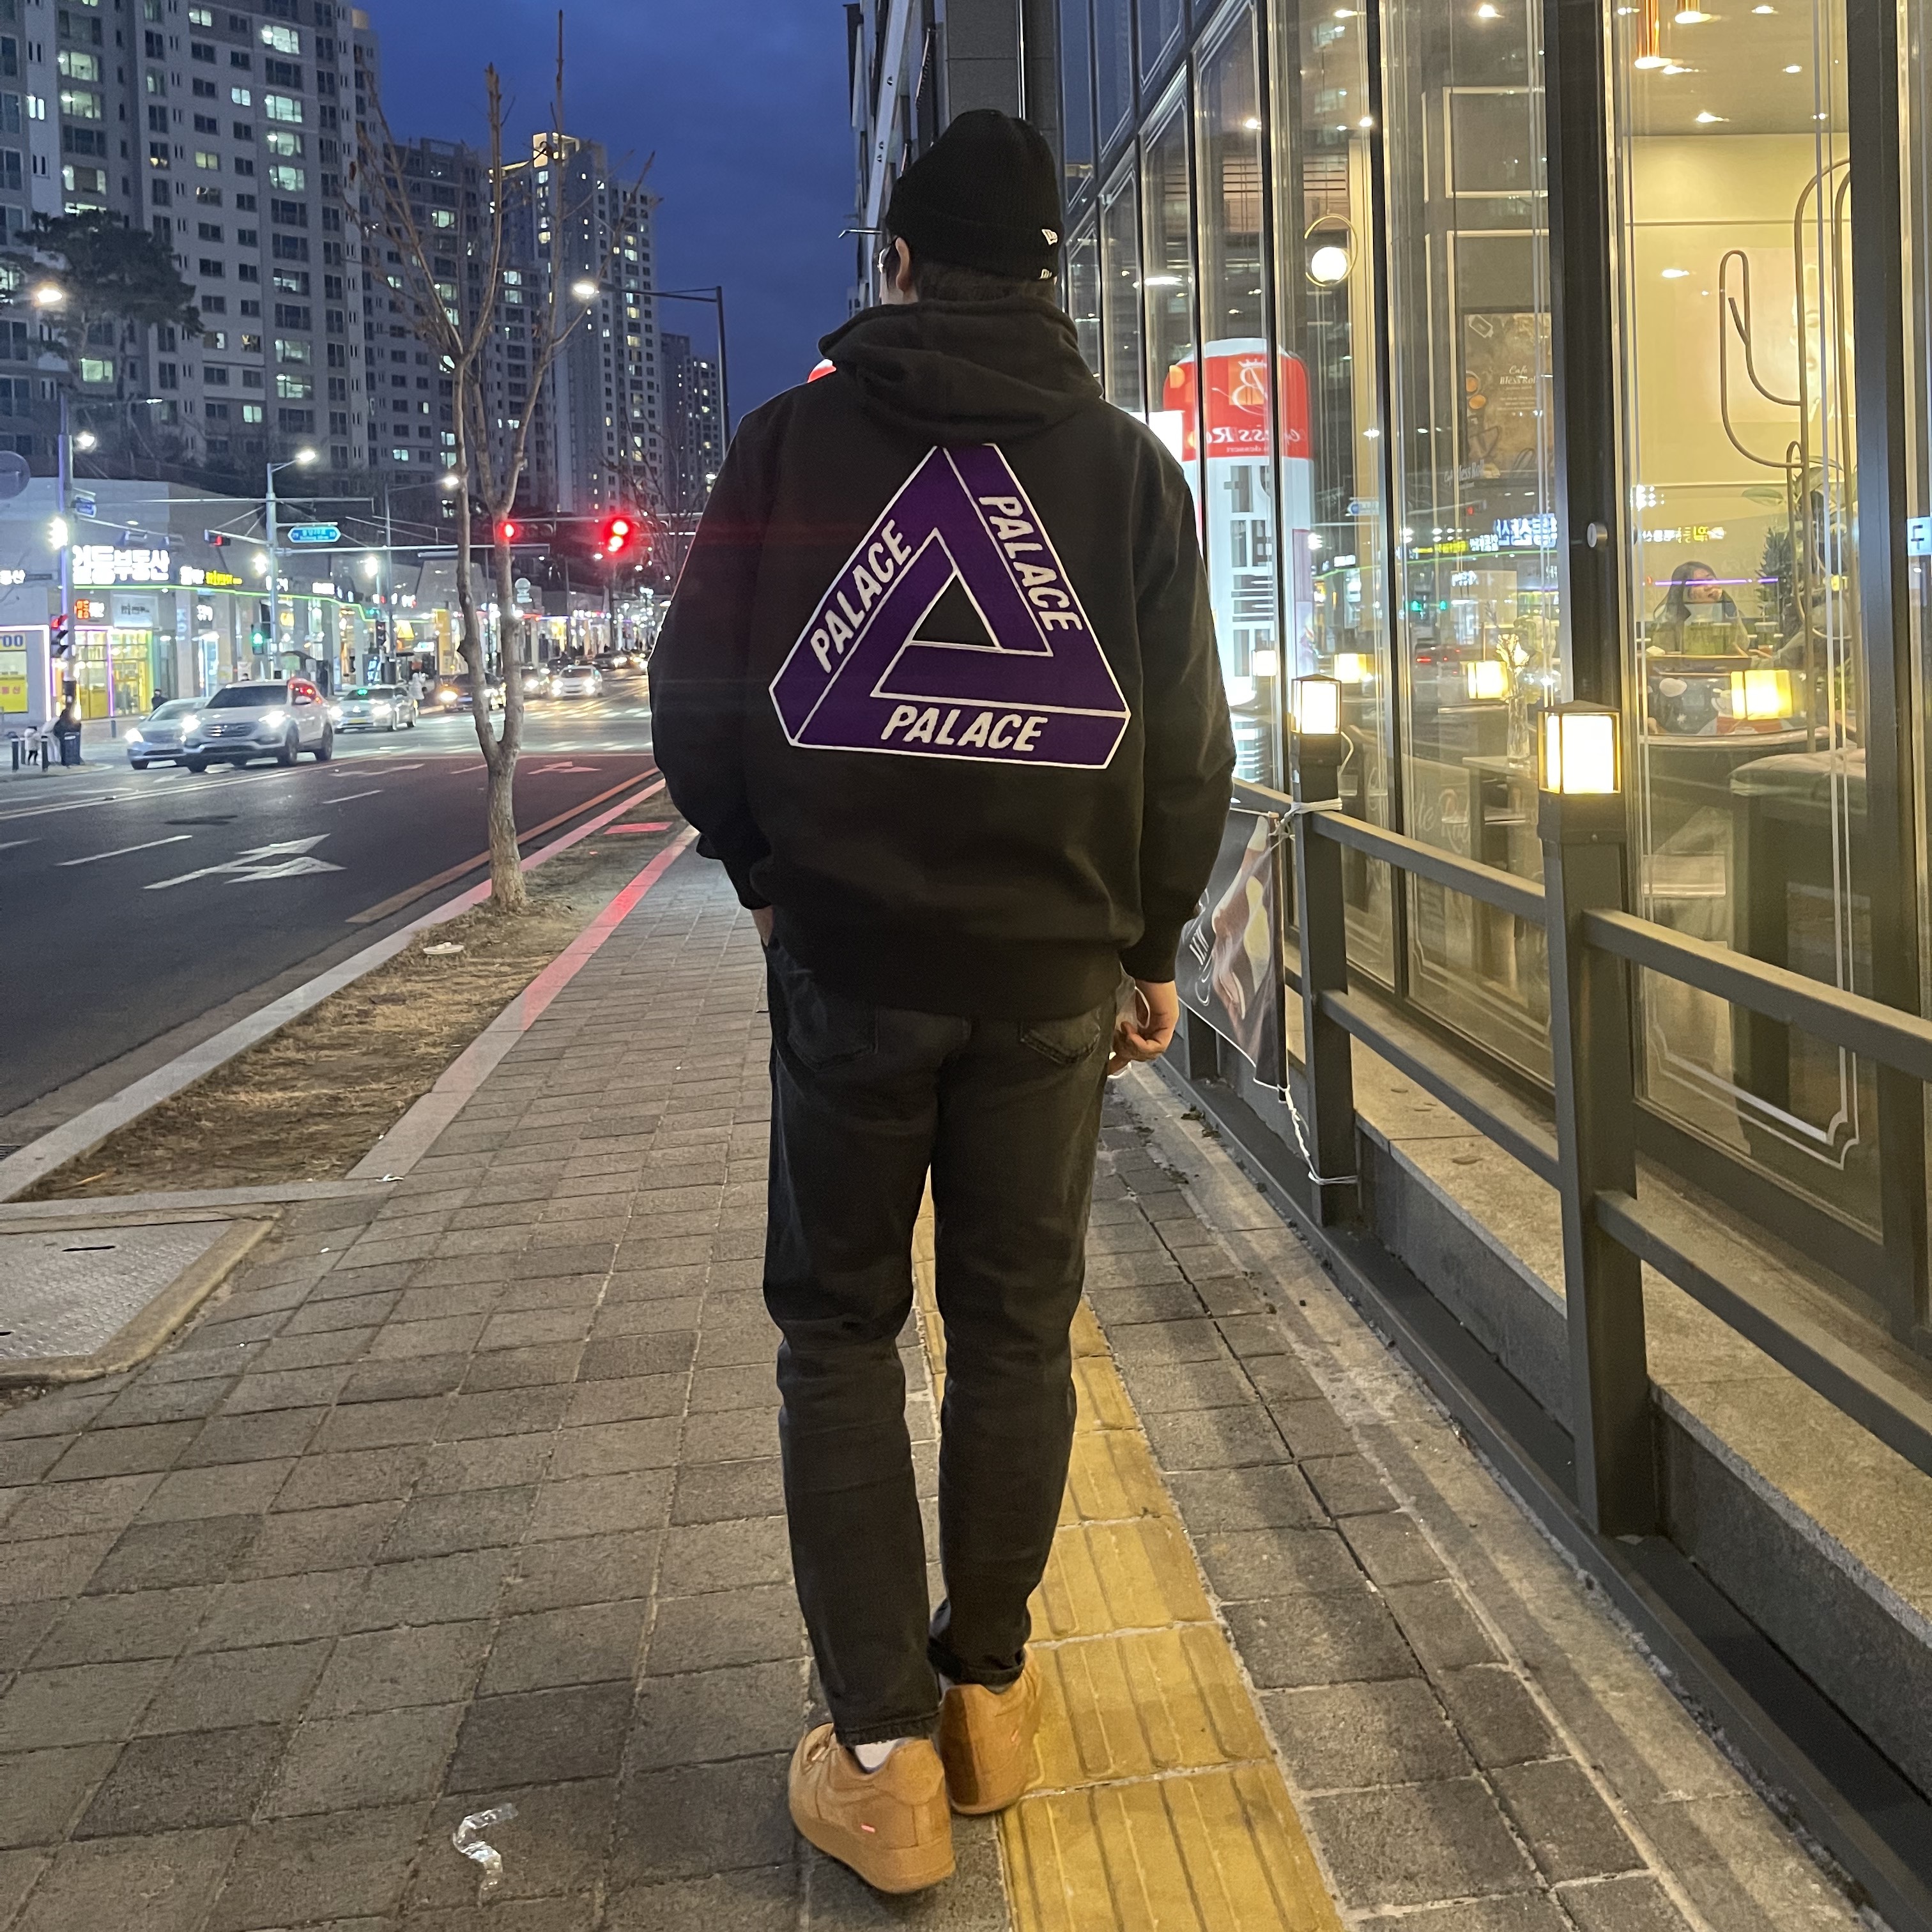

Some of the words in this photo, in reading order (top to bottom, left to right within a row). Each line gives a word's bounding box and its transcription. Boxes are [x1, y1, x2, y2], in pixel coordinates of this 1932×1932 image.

[810, 519, 912, 673] PALACE
[979, 496, 1083, 631] PALACE
[880, 705, 1048, 751] PALACE
